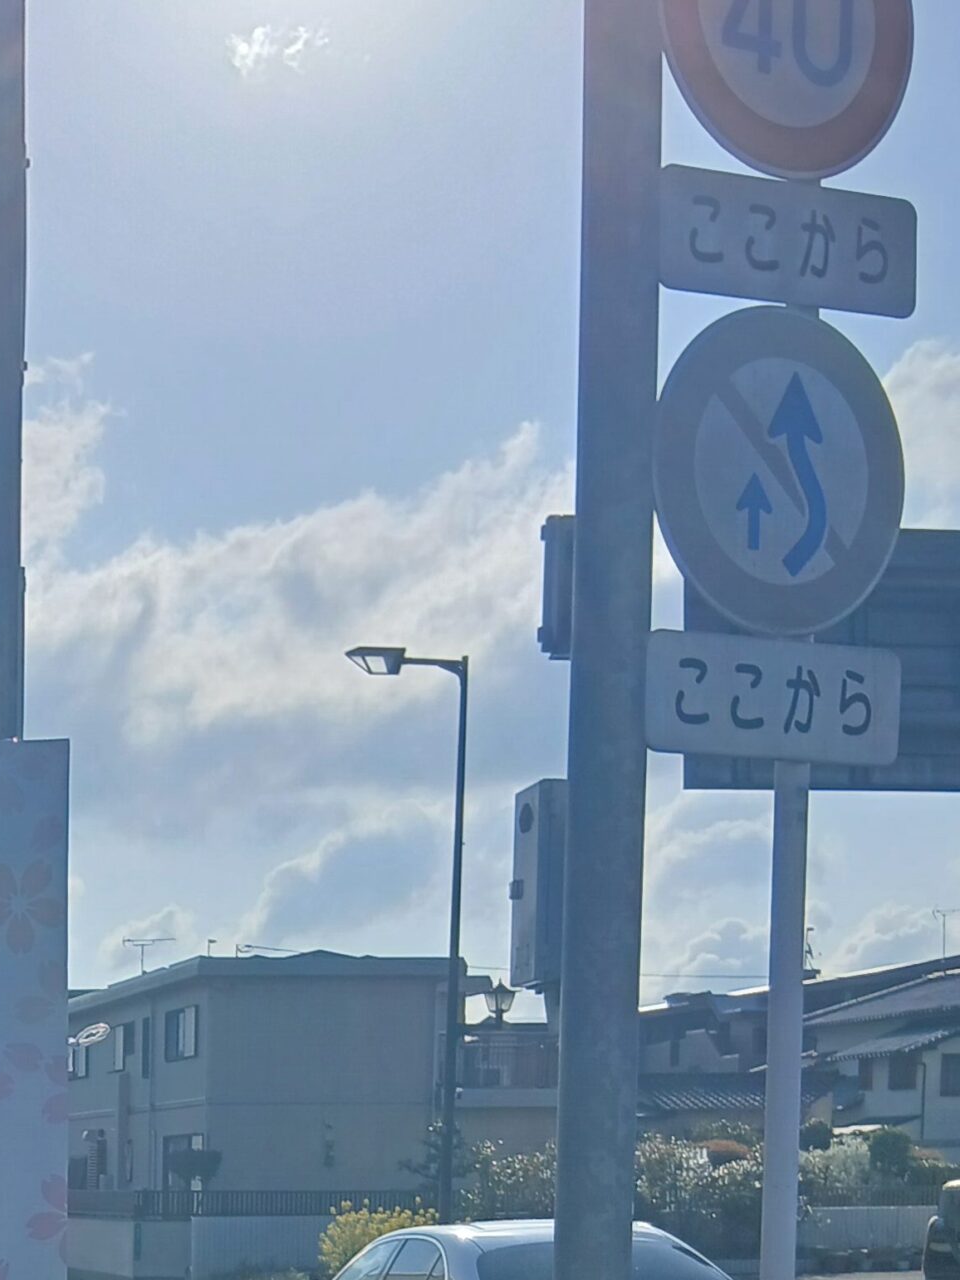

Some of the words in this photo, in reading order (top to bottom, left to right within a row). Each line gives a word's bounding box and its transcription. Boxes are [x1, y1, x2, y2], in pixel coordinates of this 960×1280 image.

[721, 0, 853, 86] 40
[688, 195, 889, 284] ここから
[675, 657, 872, 736] ここから
